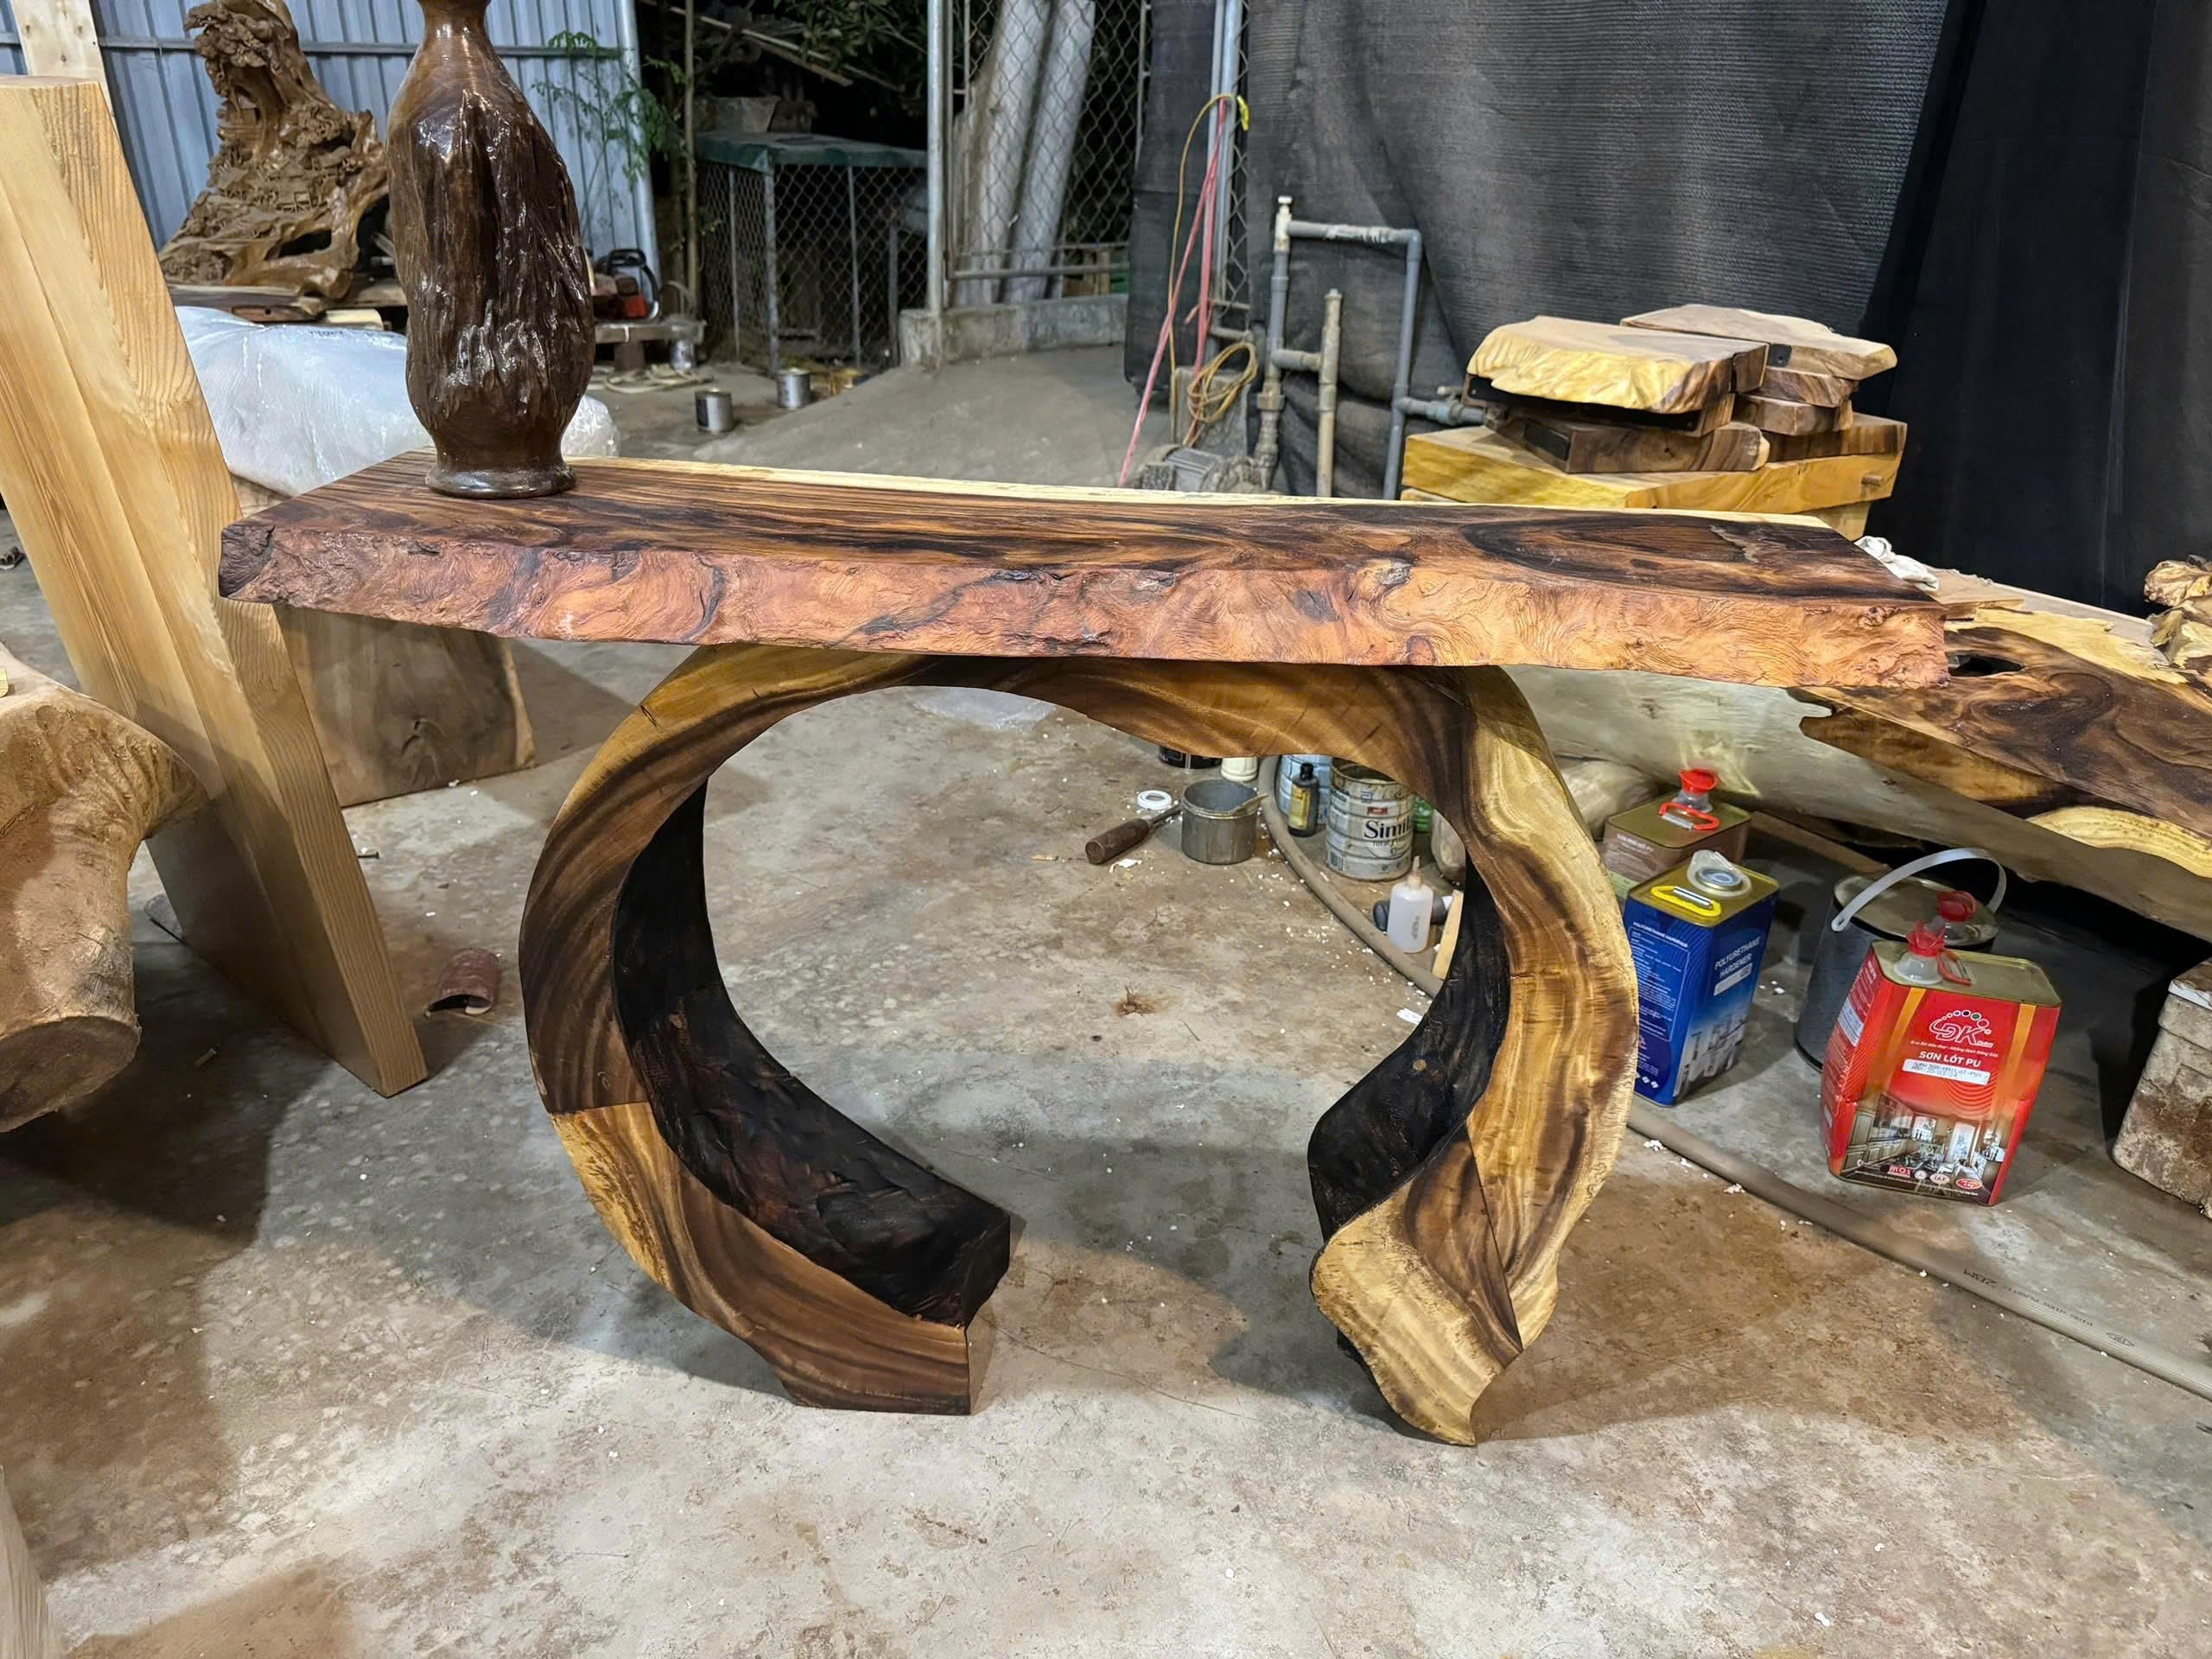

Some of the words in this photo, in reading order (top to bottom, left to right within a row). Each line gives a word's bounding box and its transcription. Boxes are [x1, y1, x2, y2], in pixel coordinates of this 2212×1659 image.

[1363, 816, 1411, 839] Simil
[1714, 936, 1762, 969] POLYURETHANE
[1719, 954, 1752, 977] HARDENER
[1918, 1051, 1942, 1061] SƠN
[1942, 1053, 1965, 1065] LÓT
[1965, 1058, 1982, 1067] PU
